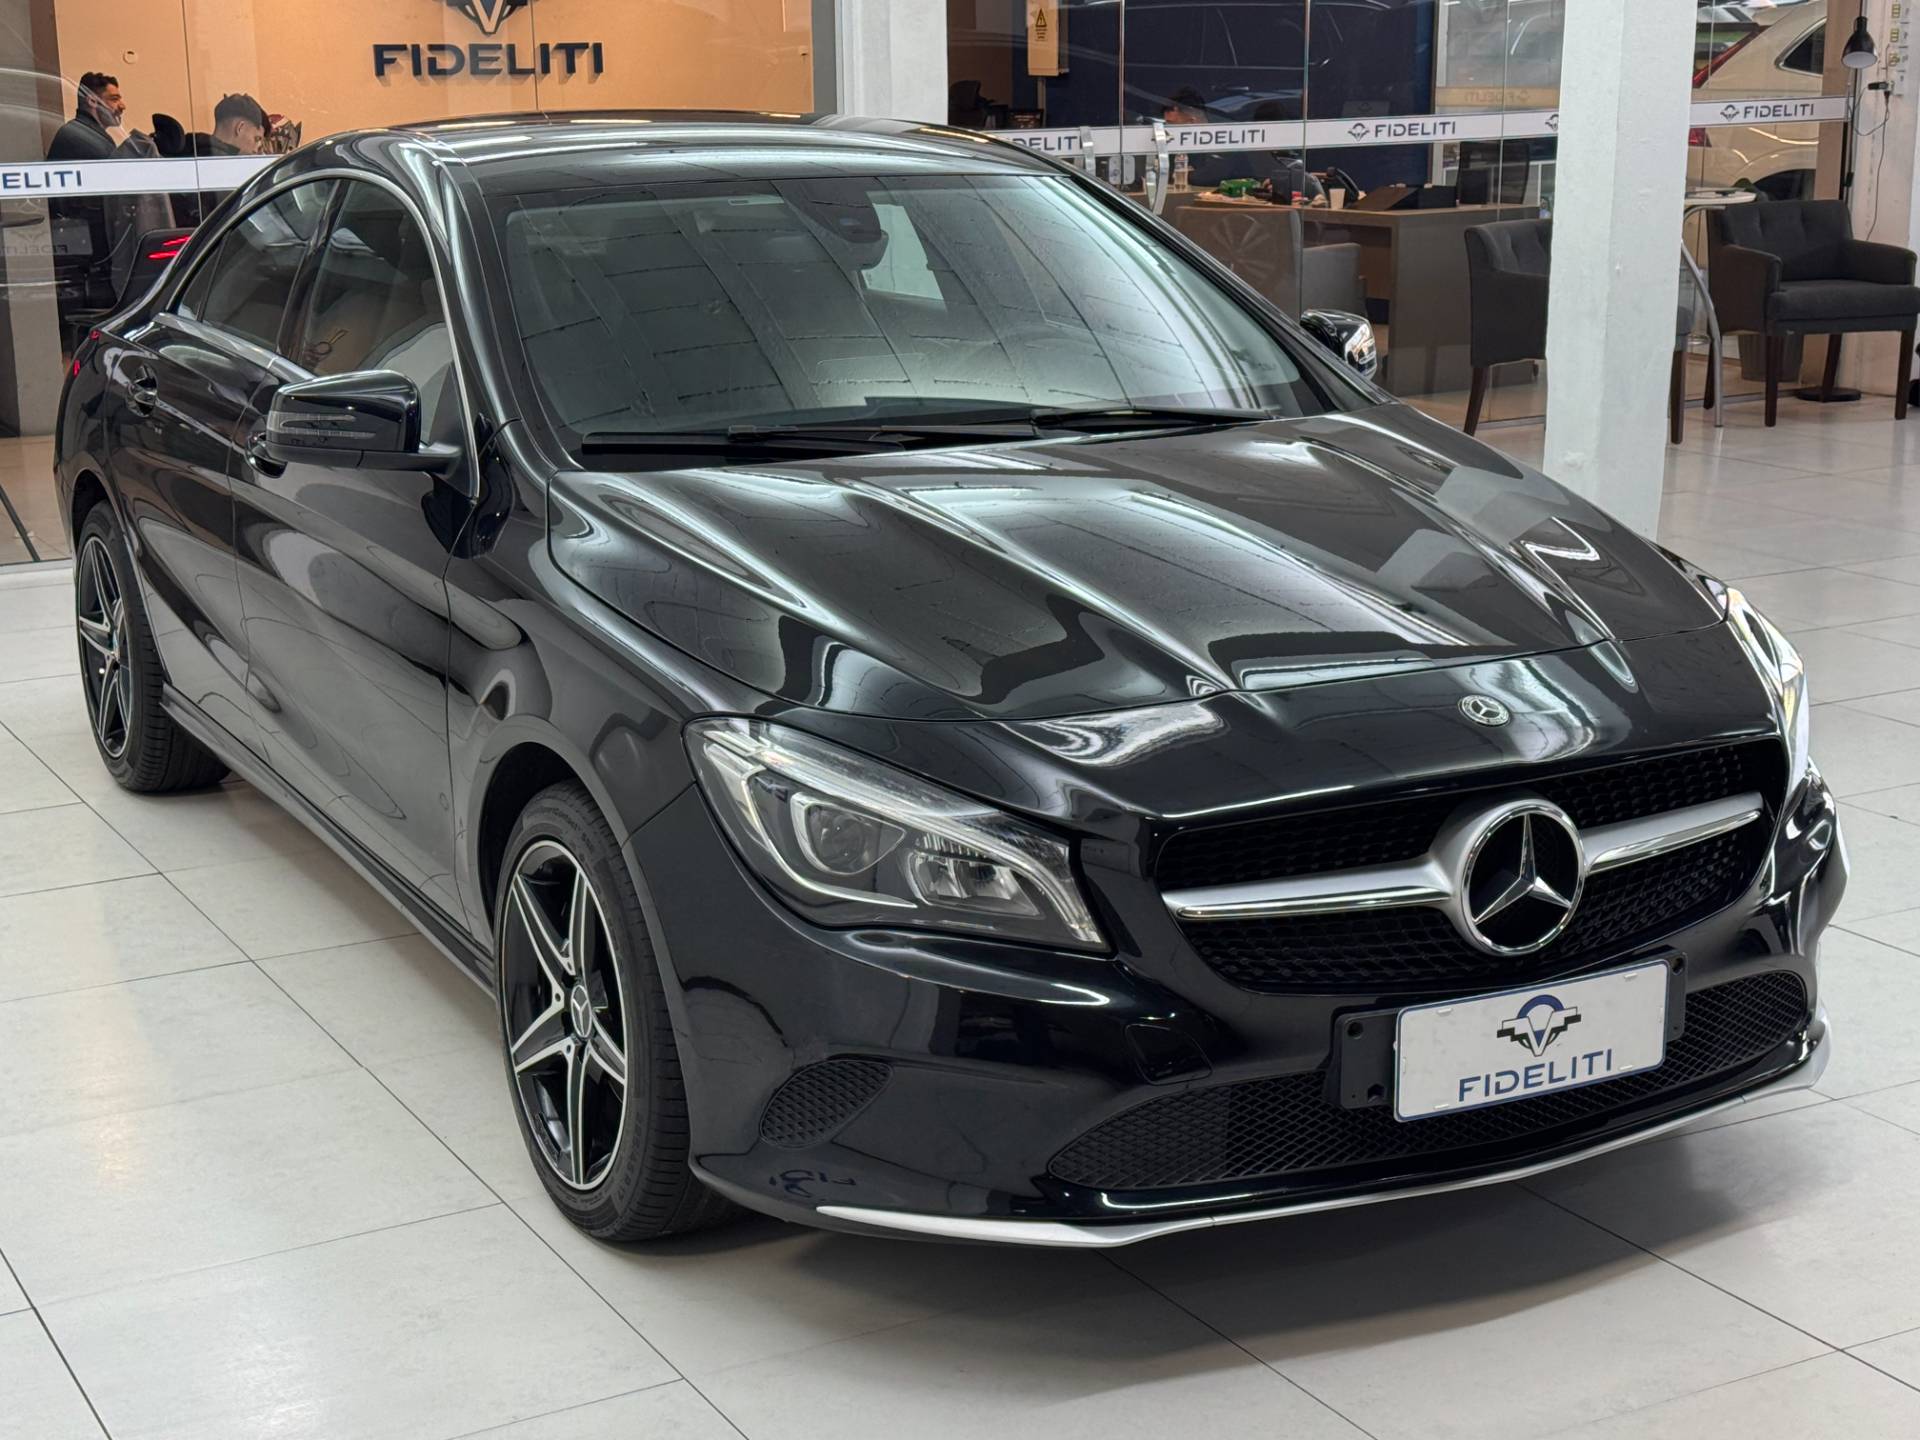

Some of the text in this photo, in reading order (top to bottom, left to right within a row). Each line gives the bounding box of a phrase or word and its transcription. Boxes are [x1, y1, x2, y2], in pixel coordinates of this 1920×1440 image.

[373, 42, 604, 77] FIDELITI
[1743, 103, 1815, 119] FIDELITI
[1180, 129, 1265, 146] FIDELITI
[1375, 121, 1456, 138] FIDELITI
[2, 170, 82, 189] ELITI
[1458, 1048, 1612, 1102] FIDELITI
